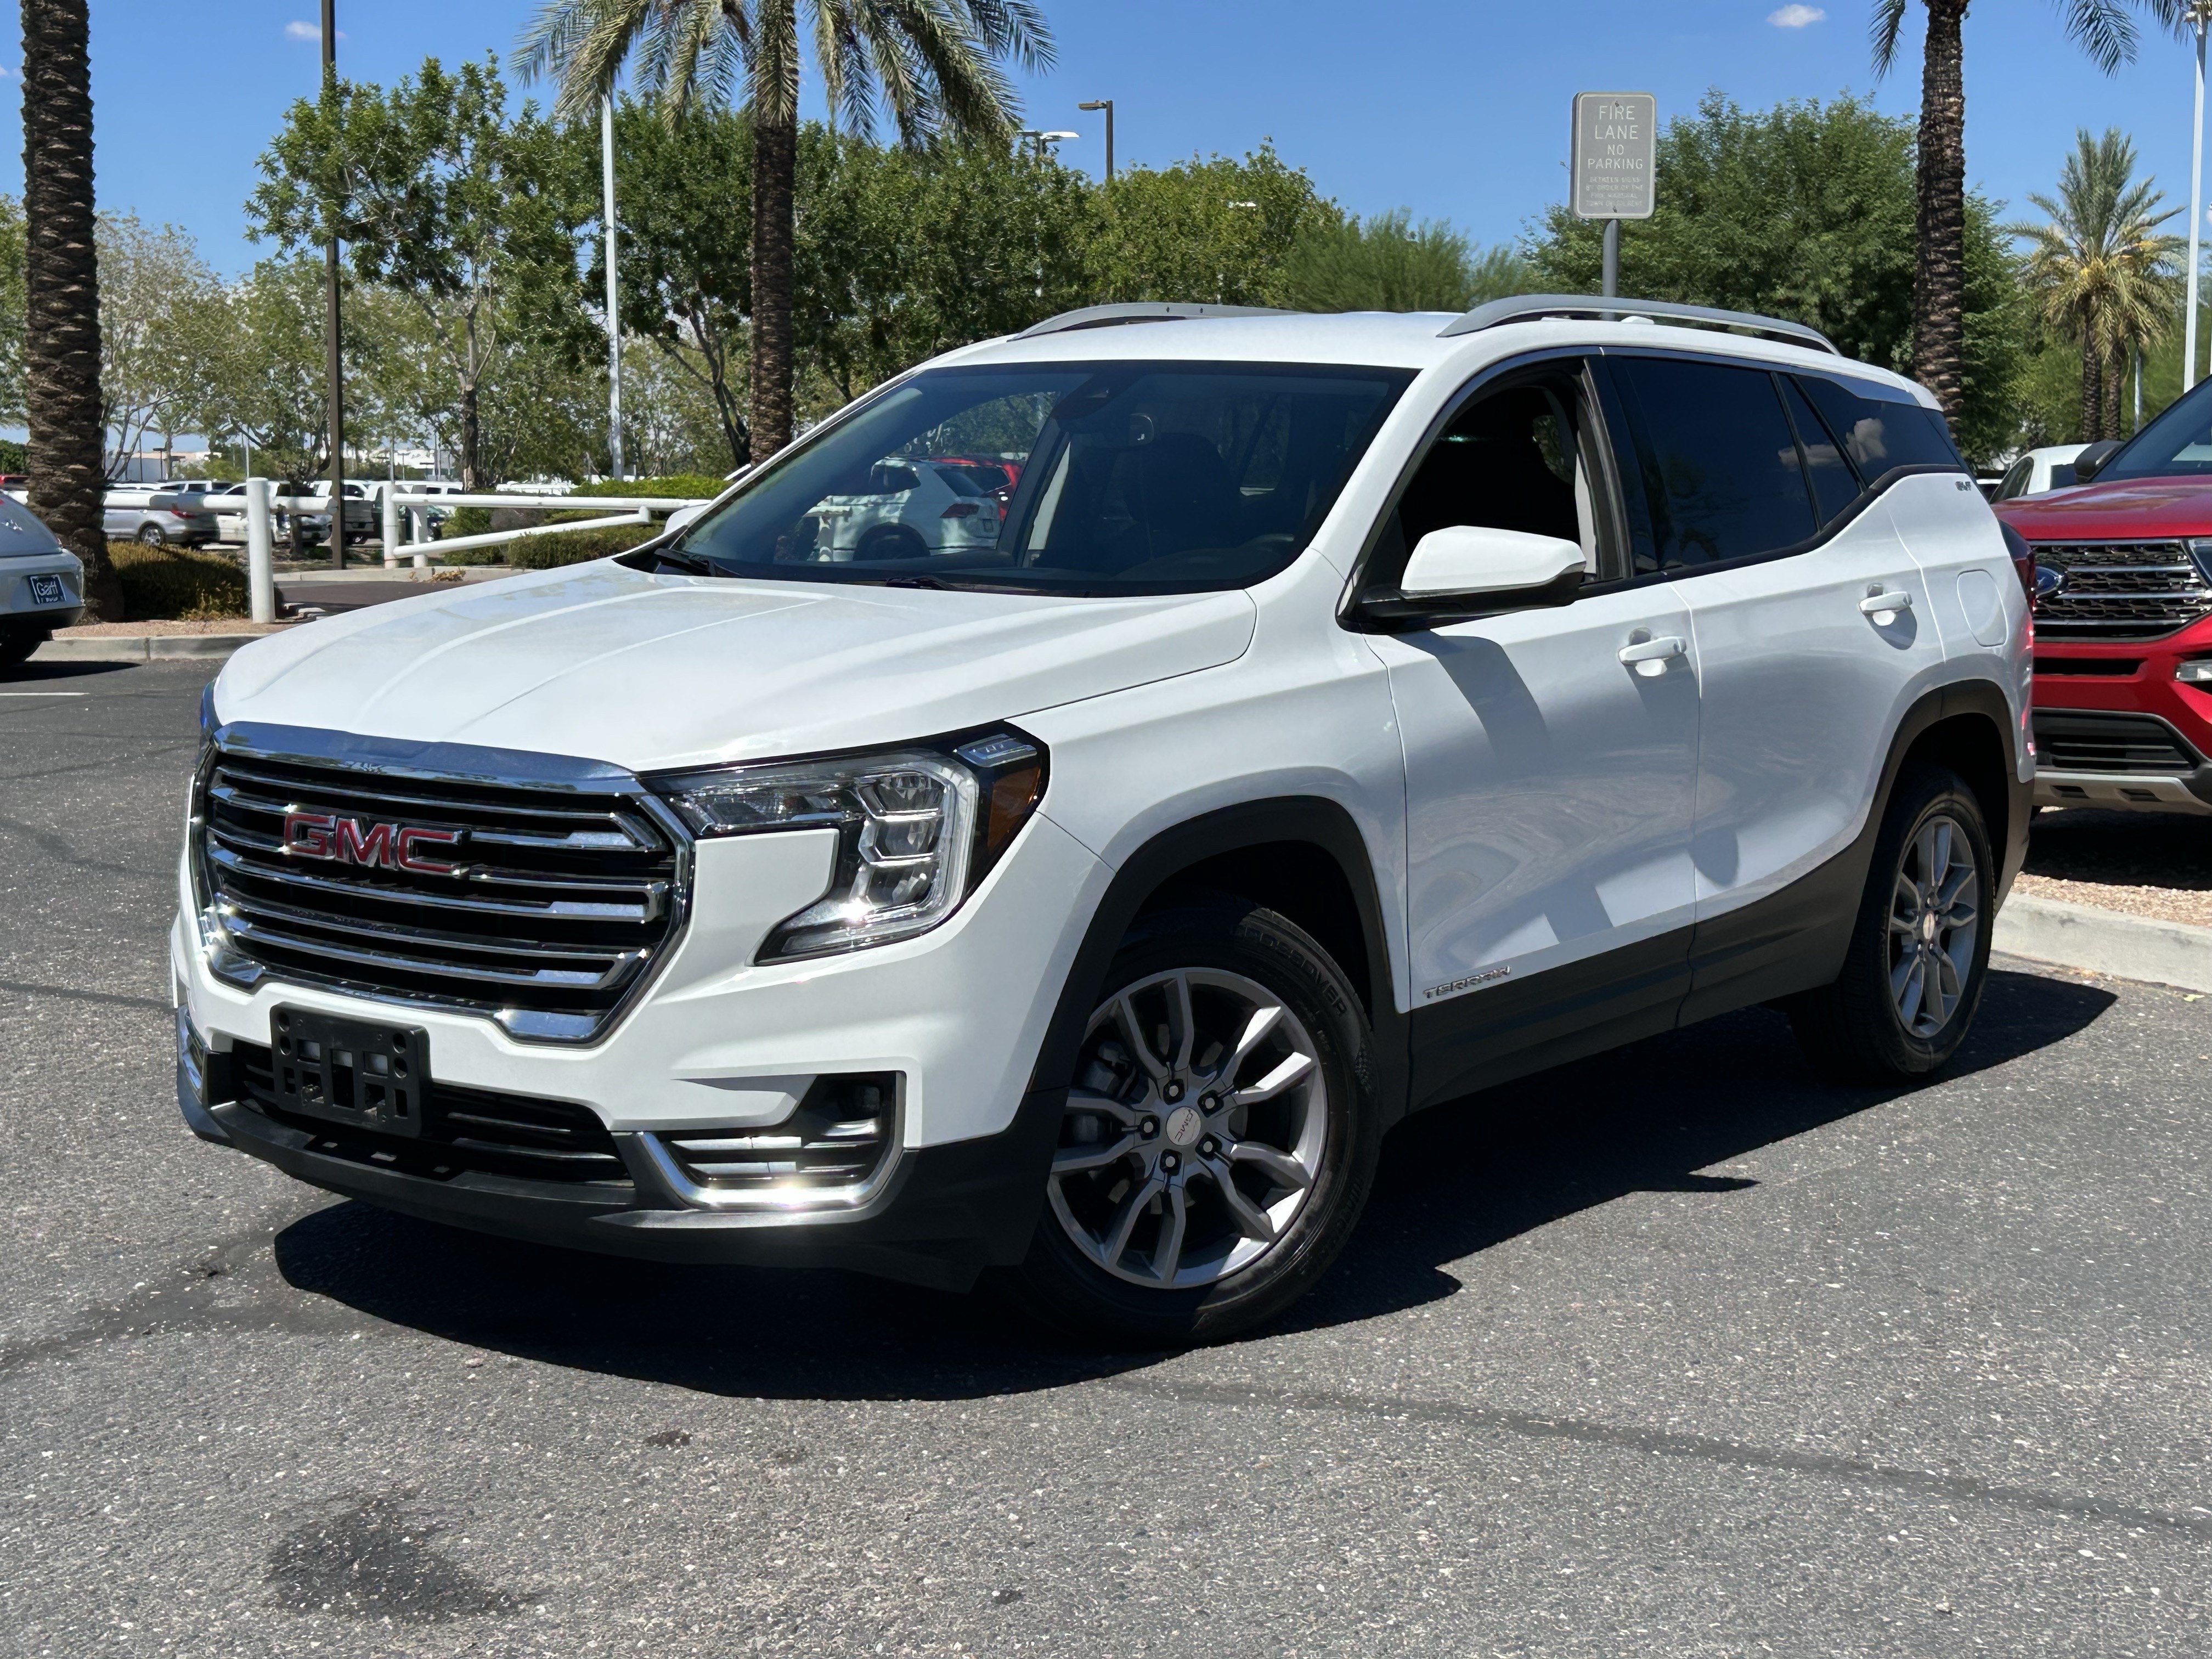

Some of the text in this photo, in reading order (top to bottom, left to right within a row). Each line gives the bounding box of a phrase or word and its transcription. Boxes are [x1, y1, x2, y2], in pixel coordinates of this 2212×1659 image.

[1599, 105, 1635, 120] FIRE
[1595, 125, 1638, 139] LANE
[1607, 144, 1624, 155] NO
[1588, 158, 1643, 170] PARKING
[284, 812, 470, 878] GMC
[1175, 1112, 1193, 1142] GMC
